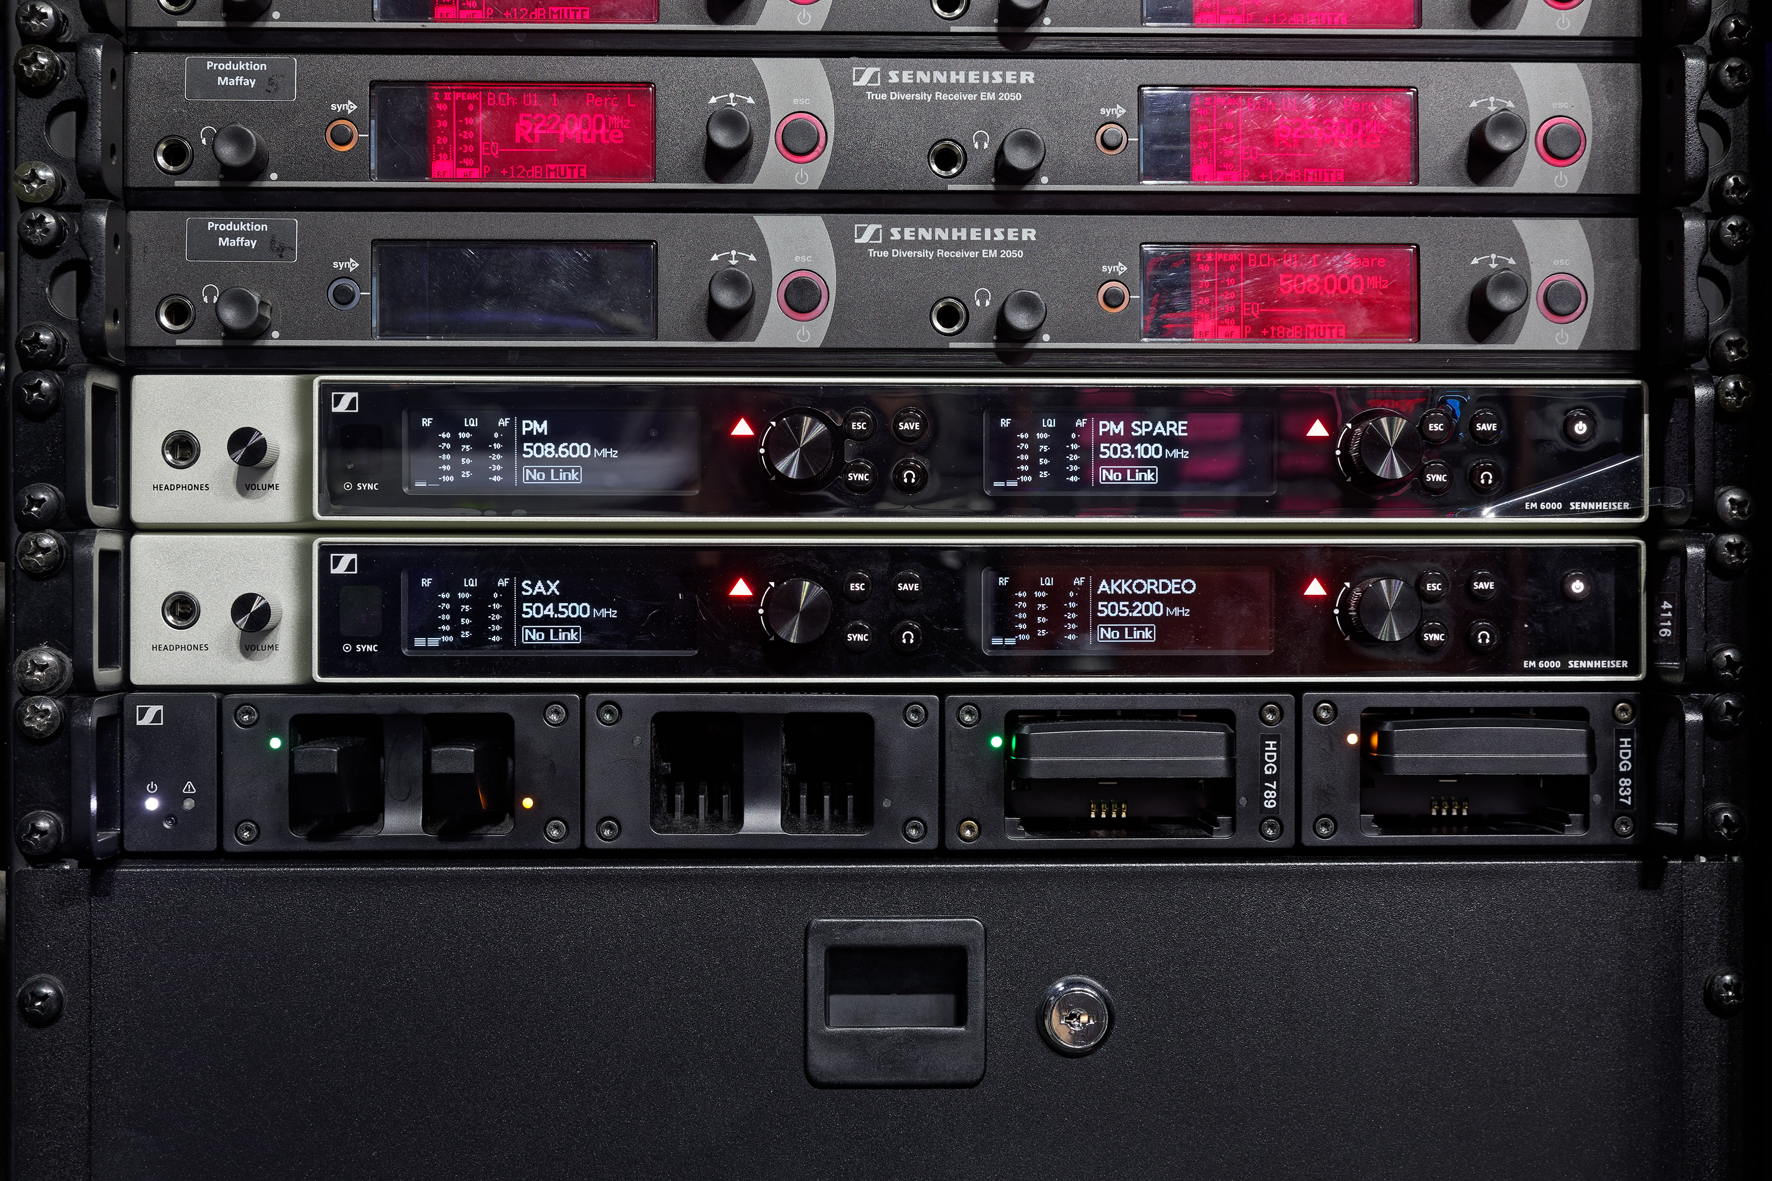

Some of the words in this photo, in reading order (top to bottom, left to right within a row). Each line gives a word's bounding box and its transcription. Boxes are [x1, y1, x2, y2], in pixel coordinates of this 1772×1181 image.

[207, 61, 267, 72] Produktion
[217, 76, 256, 88] Maffay
[888, 70, 1035, 84] SENNHEISER
[866, 92, 887, 100] True
[890, 92, 933, 102] Diversity
[936, 92, 978, 101] Receiver
[980, 92, 996, 101] EM
[998, 92, 1022, 101] 2050
[546, 164, 586, 178] MUTE
[207, 221, 268, 232] Produktion
[890, 228, 1037, 241] SENNHEISER
[218, 236, 257, 249] Maffay
[868, 249, 889, 258] True
[892, 249, 934, 260] Diversity
[937, 249, 980, 258] Receiver
[982, 250, 998, 258] EM
[1000, 250, 1024, 258] 2050
[1306, 325, 1346, 338] MUTE
[422, 418, 433, 426] RF
[464, 418, 478, 426] LQI
[498, 418, 510, 426] AF
[851, 421, 867, 430] ESC
[898, 421, 920, 430] SAVE
[1000, 419, 1012, 427] RF
[1042, 419, 1056, 427] LQI
[1076, 419, 1088, 427] AF
[1428, 422, 1444, 432] ESC
[1476, 422, 1498, 432] SAVE
[522, 420, 548, 436] PM
[1099, 420, 1124, 436] PM
[1131, 420, 1188, 436] SPARE
[522, 442, 591, 458] 508.600
[594, 448, 618, 458] MHz
[1099, 444, 1162, 459] 503.100
[1165, 450, 1190, 459] MHz
[526, 469, 546, 481] No
[551, 468, 580, 481] Link
[848, 472, 870, 482] SYNC
[1102, 470, 1122, 482] No
[1127, 470, 1155, 482] Link
[1426, 473, 1448, 482] SYNC
[152, 484, 210, 492] HEADPHONES
[356, 482, 379, 490] SYNC
[1524, 502, 1538, 510] EM
[1540, 502, 1562, 510] 6000
[1569, 502, 1630, 510] SENNHEISER
[421, 578, 432, 587] RF
[464, 578, 478, 587] LQI
[498, 578, 510, 587] AF
[998, 577, 1010, 586] RF
[1040, 577, 1054, 586] LQI
[1073, 577, 1086, 586] AF
[1096, 578, 1197, 595] AKKORDEO
[1426, 582, 1442, 592] ESC
[1472, 581, 1495, 590] SAVE
[522, 580, 560, 596] SAX
[850, 582, 866, 592] ESC
[897, 582, 920, 592] SAVE
[522, 602, 590, 618] 504.500
[593, 608, 618, 618] MHz
[1097, 602, 1164, 617] 505.200
[1166, 607, 1190, 617] MHz
[1658, 600, 1673, 638] 4116
[524, 628, 545, 641] No
[550, 628, 578, 641] Link
[846, 633, 869, 642] SYNC
[1100, 627, 1120, 640] No
[1124, 626, 1153, 640] Link
[1423, 633, 1445, 642] SYNC
[152, 644, 209, 652] HEADPHONES
[244, 644, 280, 652] VOLUME
[356, 644, 378, 652] SYNC
[1523, 660, 1536, 668] EM
[1538, 660, 1561, 668] 6000
[1568, 660, 1628, 668] SENNHEISER
[1264, 740, 1278, 776] HDG
[1618, 738, 1632, 772] HDG
[1264, 782, 1278, 809] 789
[1618, 778, 1632, 806] 837
